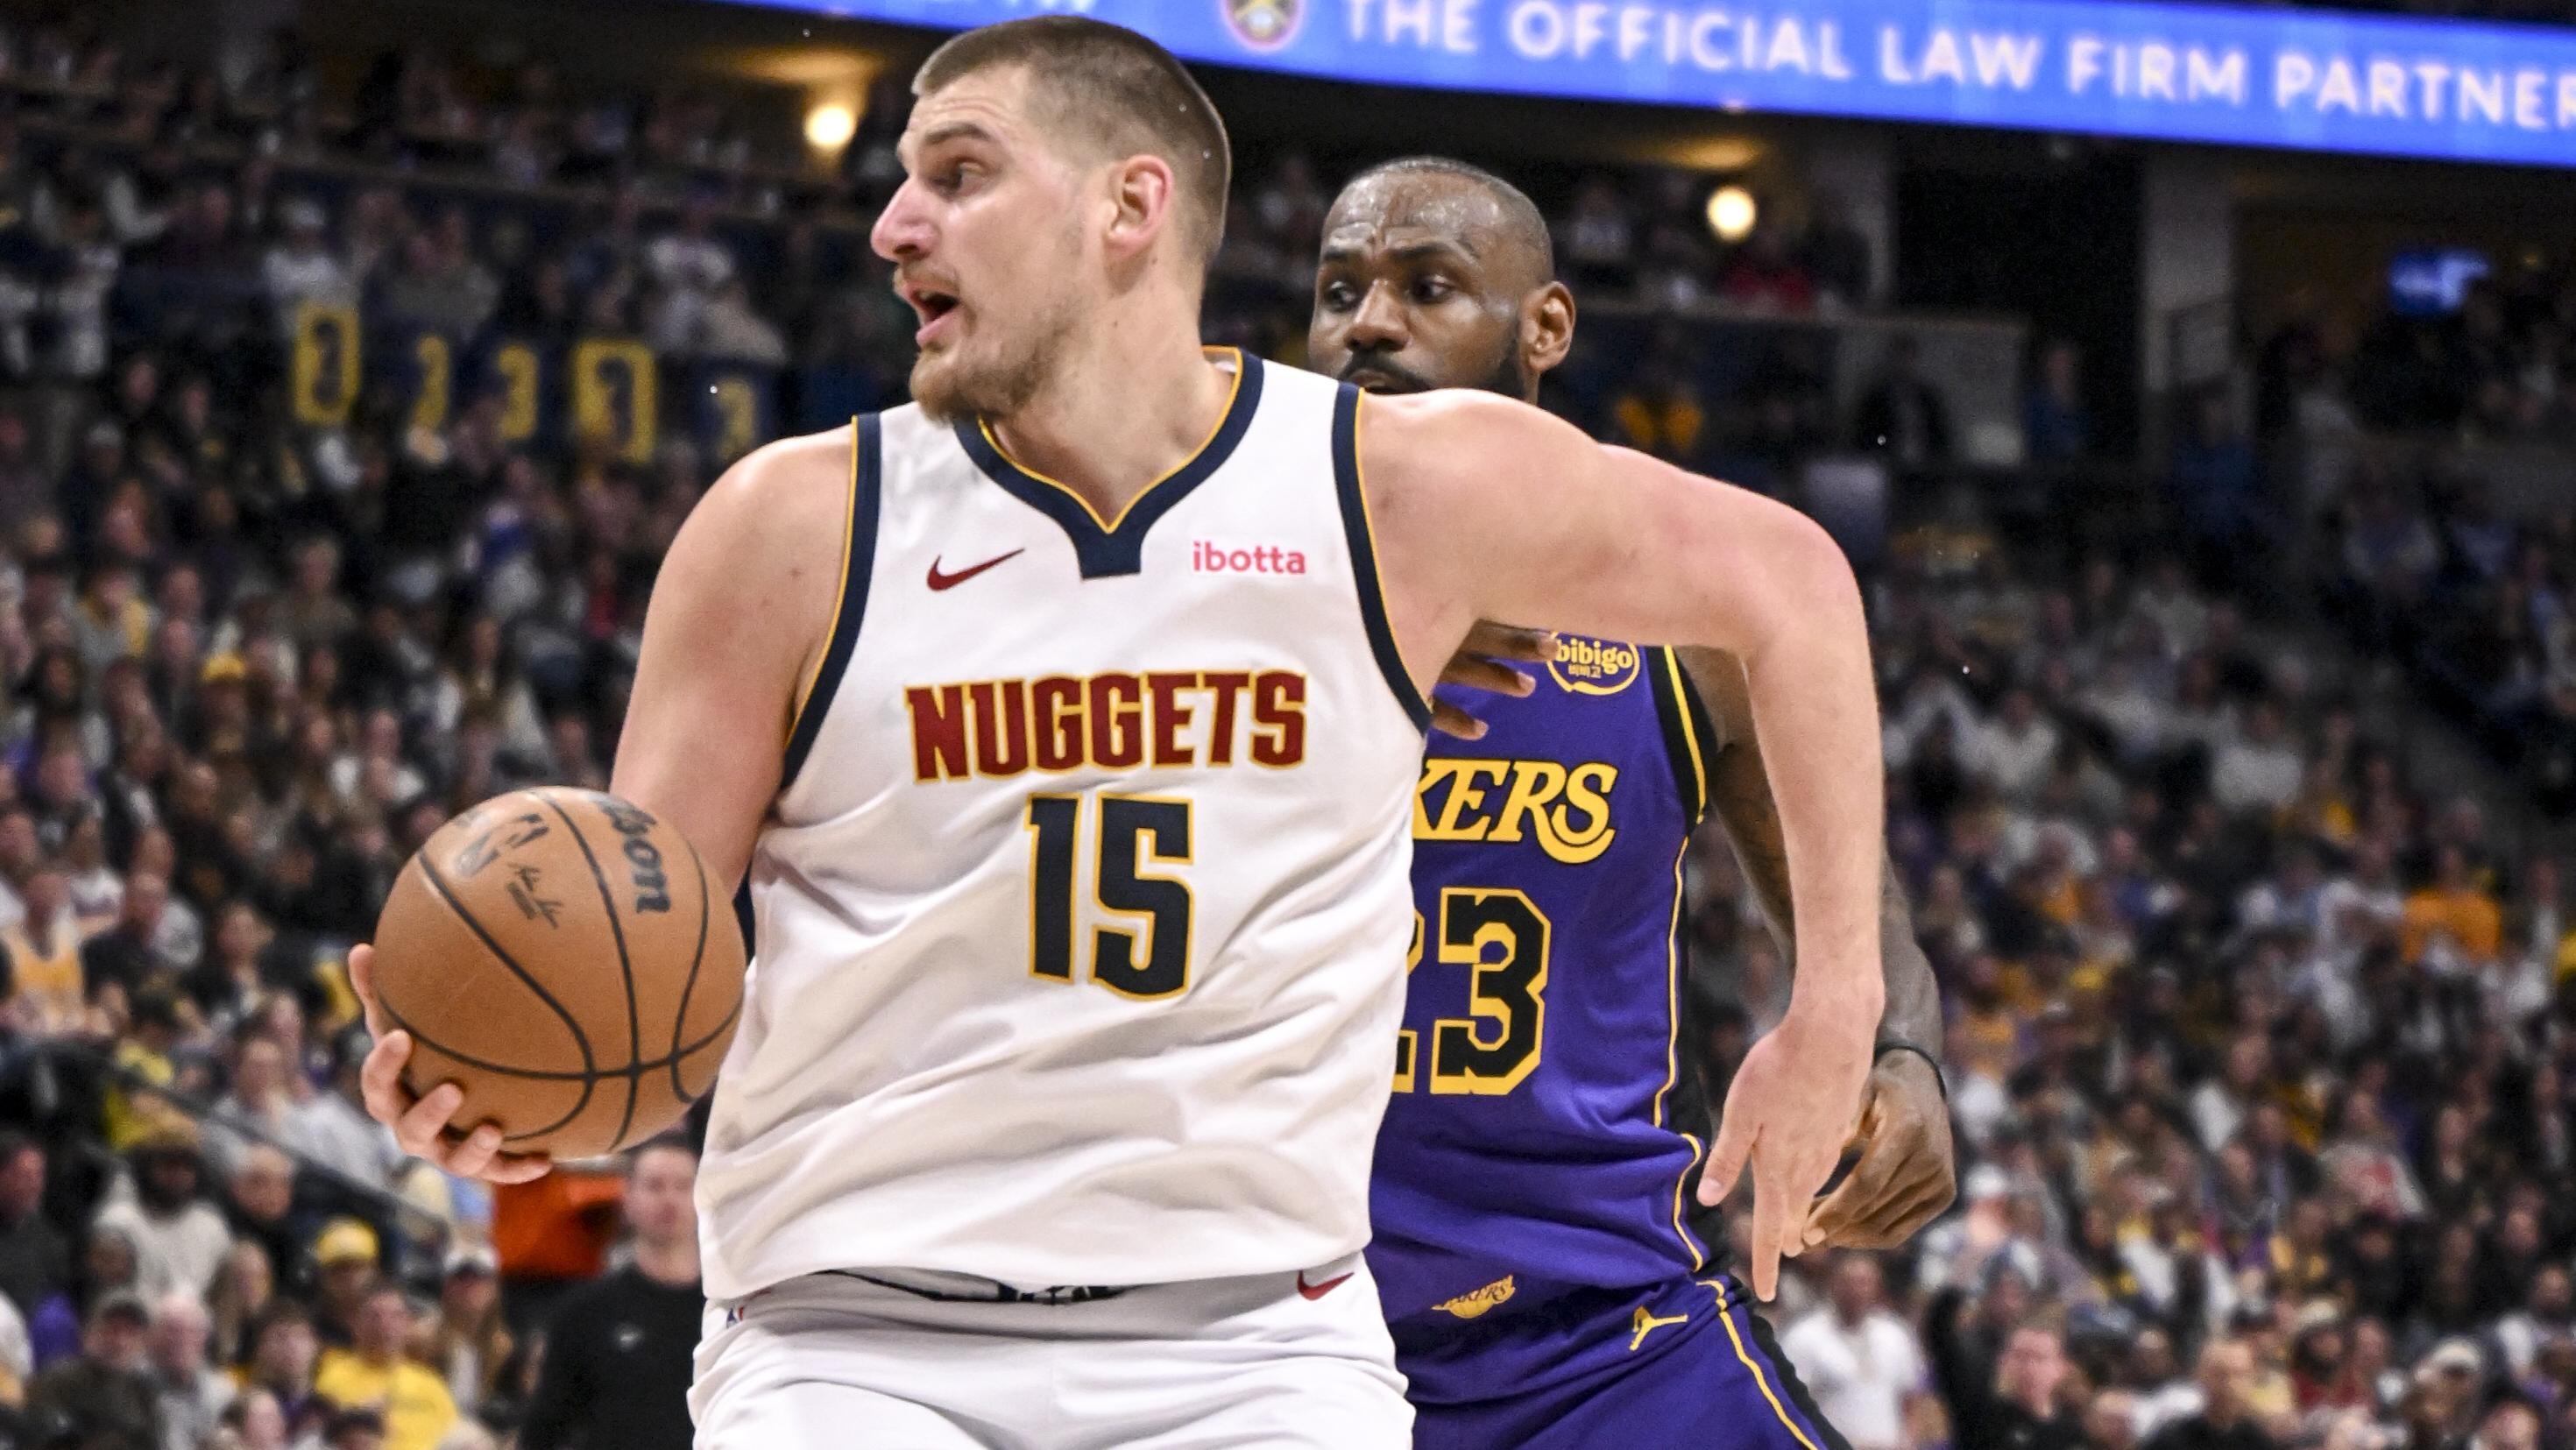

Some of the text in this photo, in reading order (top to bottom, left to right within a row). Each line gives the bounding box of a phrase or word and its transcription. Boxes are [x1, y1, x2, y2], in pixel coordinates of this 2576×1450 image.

[1348, 0, 1478, 53] THE
[1509, 3, 1854, 81] OFFICIAL
[1880, 27, 2041, 88] LAW
[2069, 39, 2248, 106] FIRM
[1192, 541, 1306, 575] ibotta
[1555, 638, 1633, 675] bibigo
[903, 668, 1307, 784] NUGGETS
[1412, 757, 1619, 865] KERS
[1023, 790, 1195, 1002] 15
